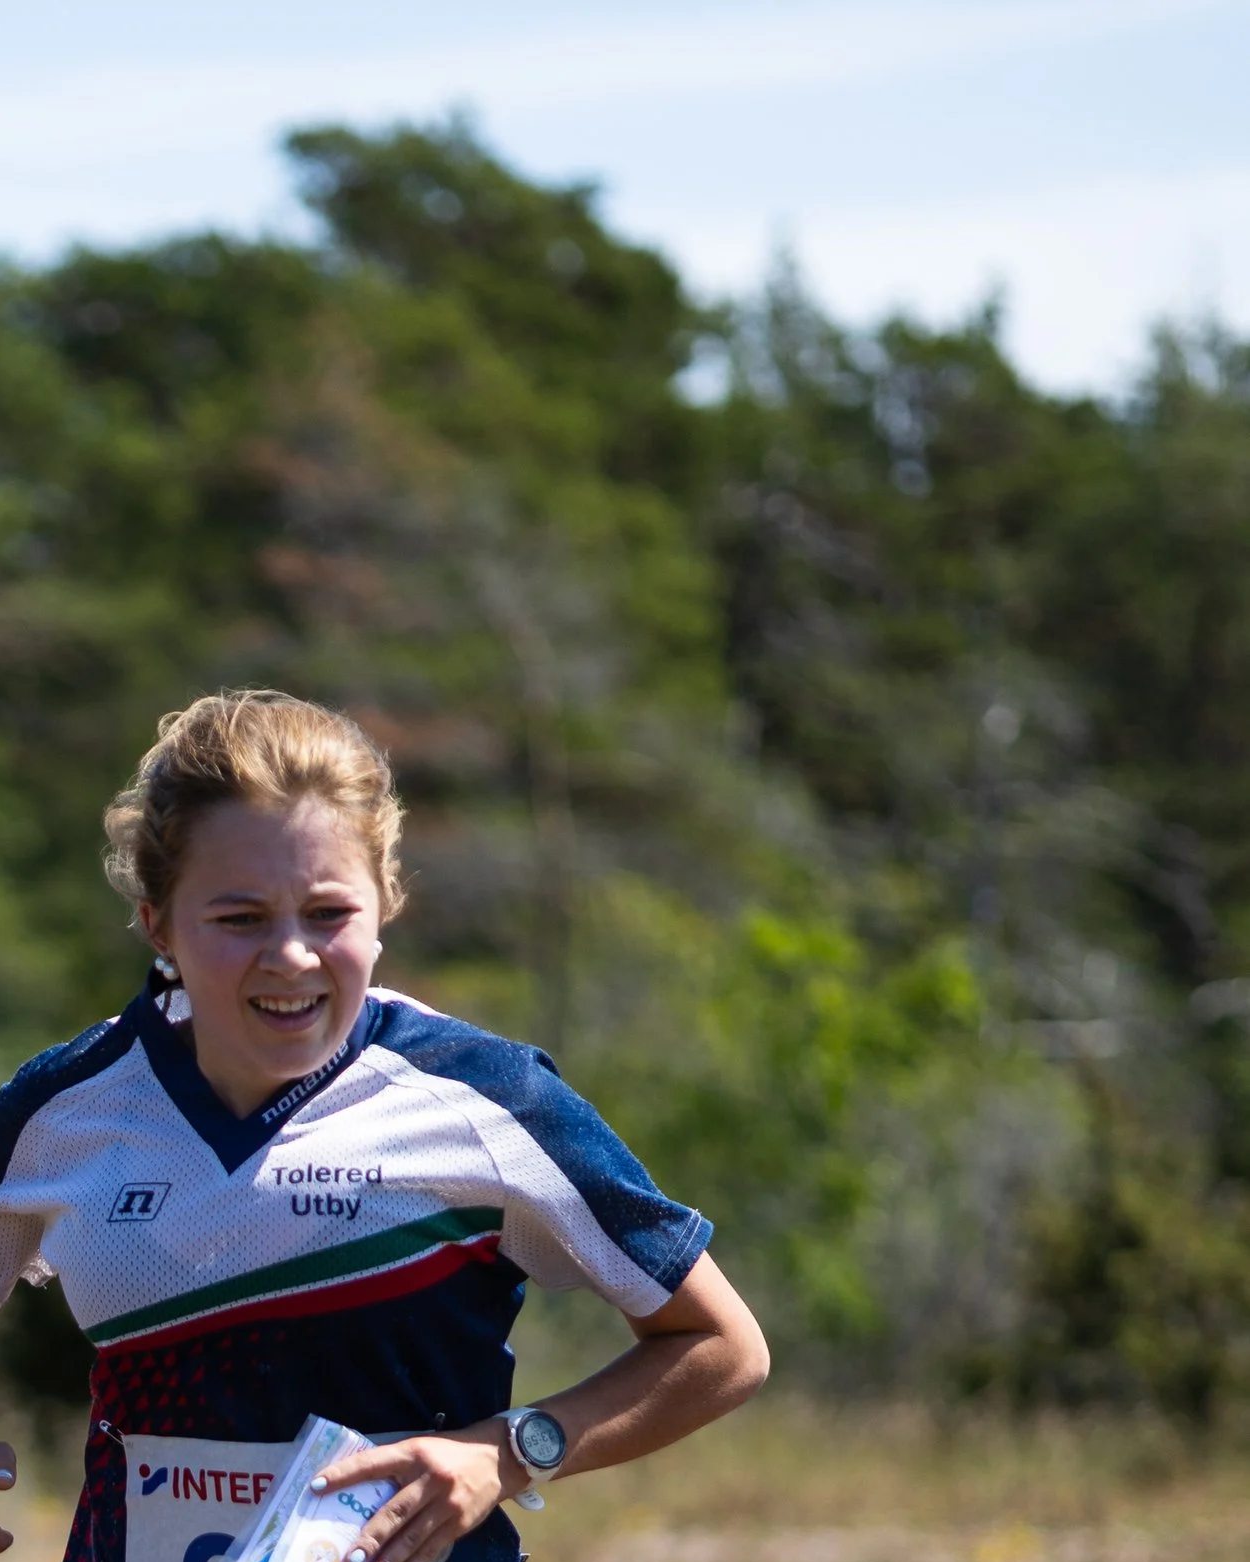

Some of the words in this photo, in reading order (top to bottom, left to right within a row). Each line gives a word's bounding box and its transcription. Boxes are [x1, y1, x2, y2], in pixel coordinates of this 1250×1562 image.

[261, 1040, 349, 1124] noname
[271, 1163, 382, 1186] Tolered
[291, 1193, 362, 1221] Utby
[337, 1491, 376, 1520] oop
